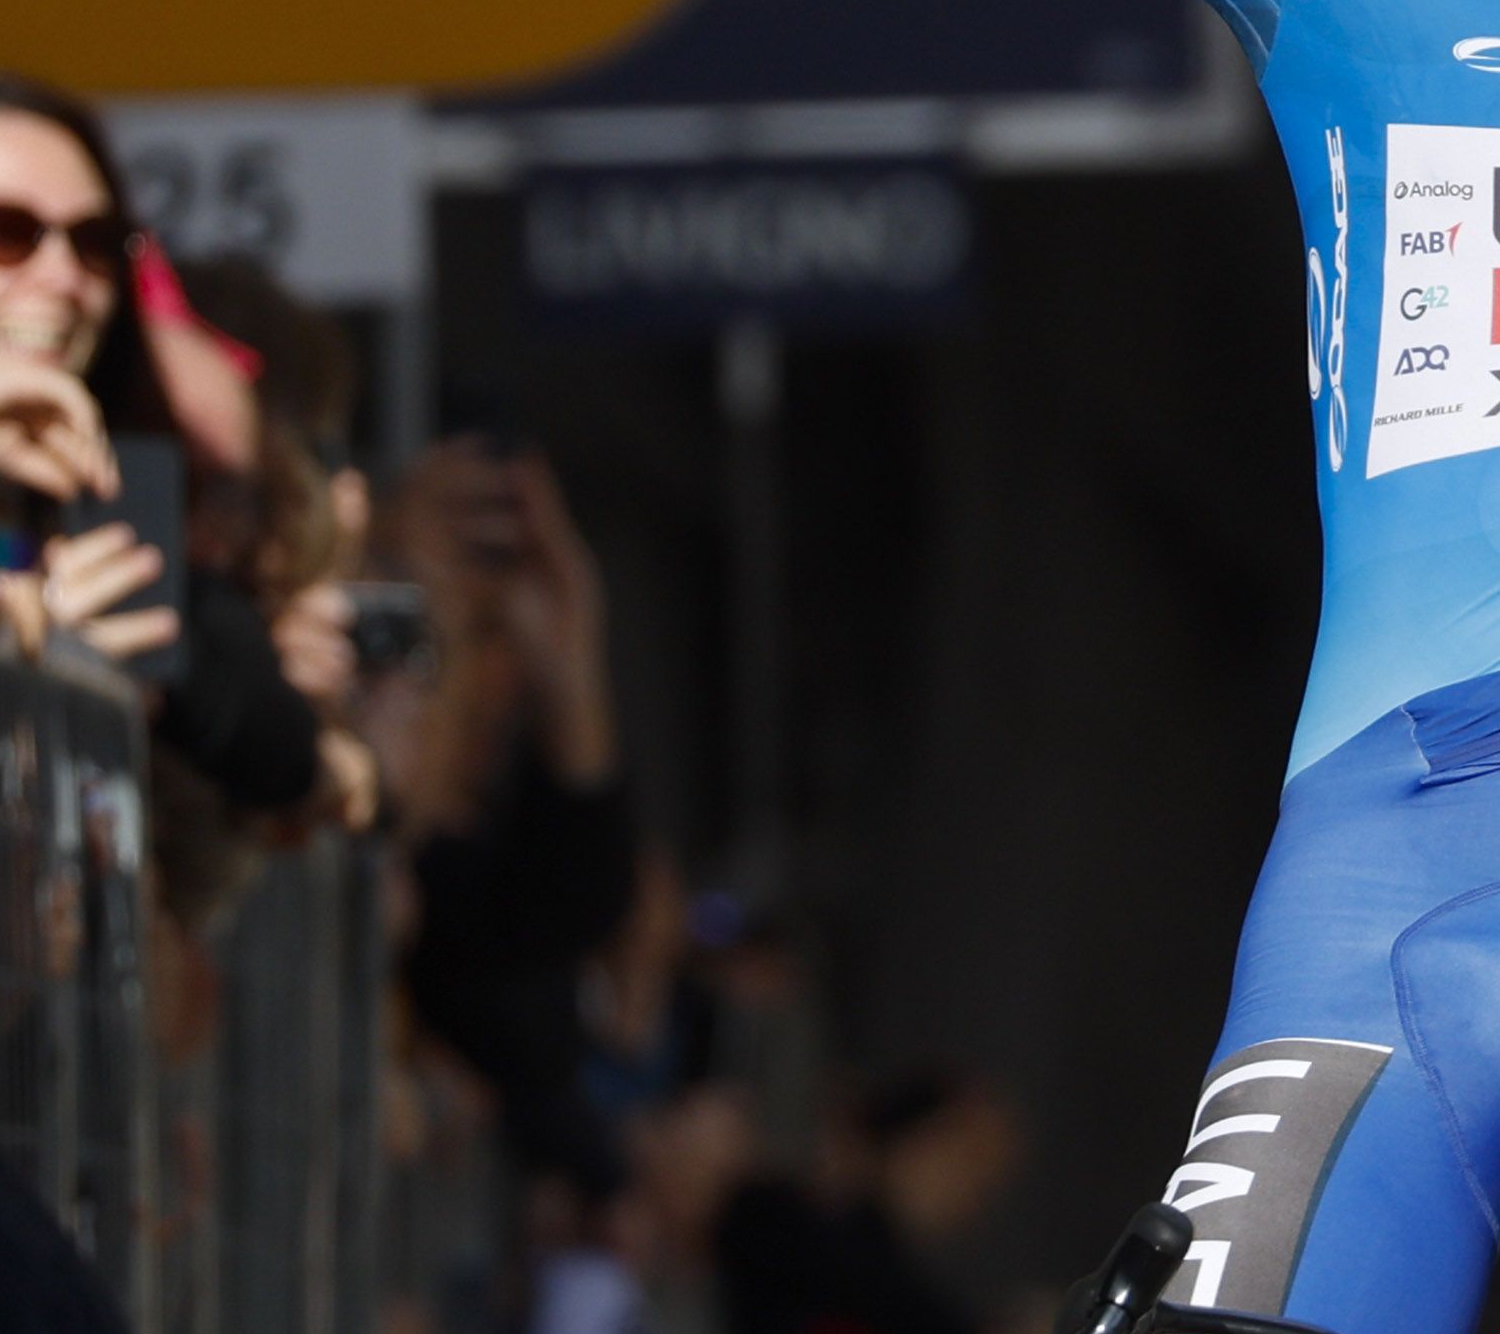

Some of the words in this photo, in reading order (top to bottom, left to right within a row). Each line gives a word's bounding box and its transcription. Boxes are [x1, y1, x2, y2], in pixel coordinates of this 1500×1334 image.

[1409, 181, 1474, 201] Analog
[1400, 285, 1450, 321] G42
[1394, 344, 1450, 377] ADQ
[1373, 409, 1423, 427] RICHARD
[1424, 402, 1465, 417] MILLE
